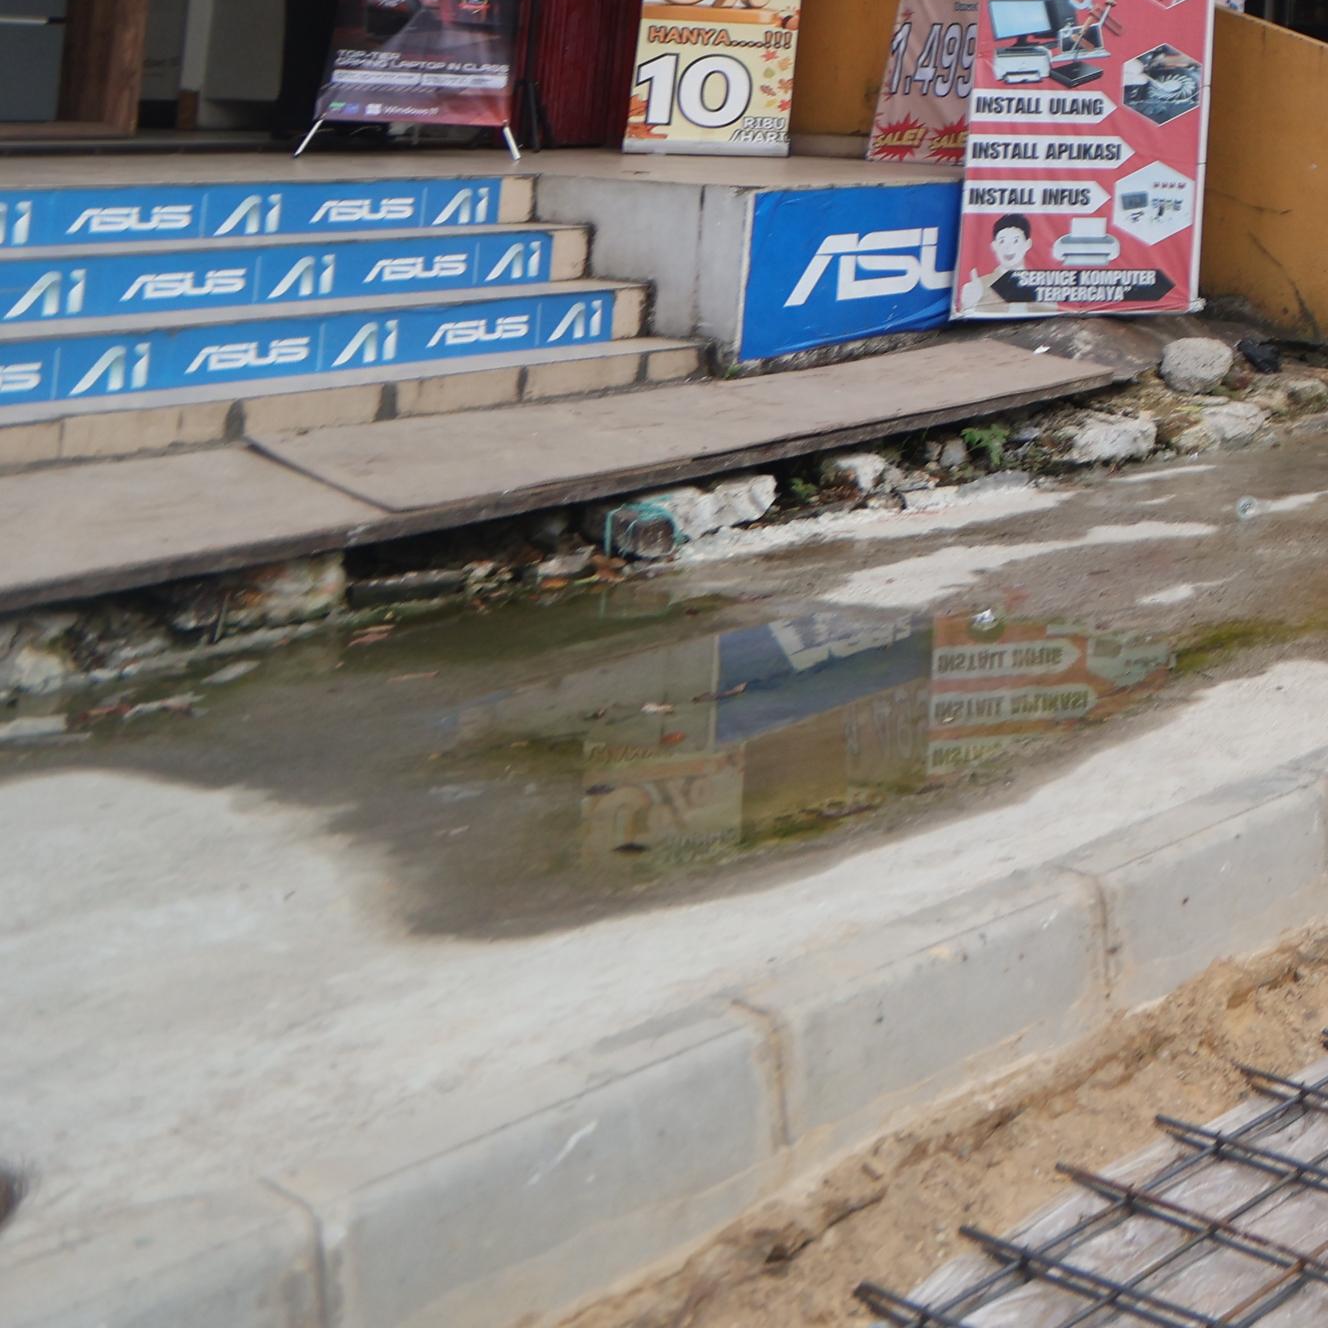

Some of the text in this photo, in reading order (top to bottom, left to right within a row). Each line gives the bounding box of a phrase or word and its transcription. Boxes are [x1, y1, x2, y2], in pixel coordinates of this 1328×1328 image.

[635, 52, 753, 129] 10
[975, 96, 1105, 116] INSTALL ULANG
[743, 116, 786, 131] RIBU
[971, 141, 1122, 162] INSTALL APLIKASI
[968, 187, 1092, 206] INSTALL INFUS
[66, 204, 194, 235] ASUS
[310, 197, 416, 224] ASUS
[119, 268, 247, 303] ASUS
[363, 253, 468, 284] ASUS
[1081, 270, 1157, 286] KOMPUTER
[184, 337, 311, 375] ASUS
[426, 315, 530, 350] ASUS
